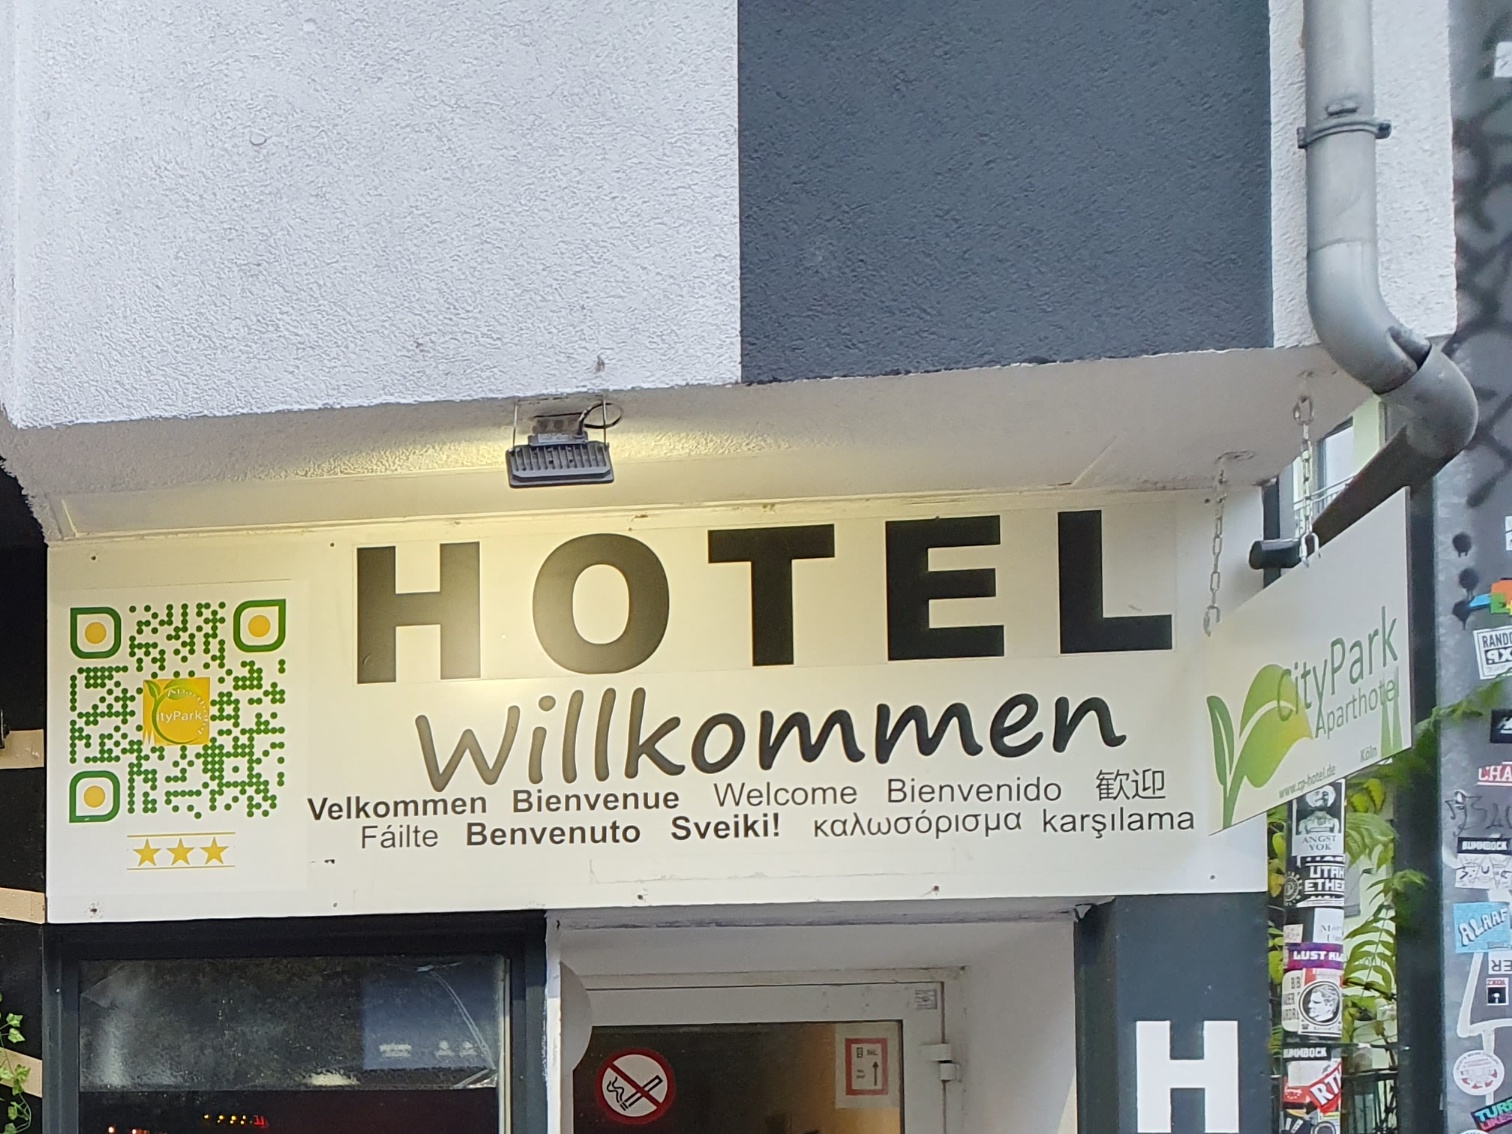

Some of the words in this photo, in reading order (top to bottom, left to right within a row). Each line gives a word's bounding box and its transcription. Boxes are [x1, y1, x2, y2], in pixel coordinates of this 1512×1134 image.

[356, 510, 1172, 684] HOTEL
[1277, 606, 1398, 722] CityPark
[415, 686, 1126, 791] Willkommen
[1360, 746, 1378, 763] Köln
[307, 791, 487, 821] Velkommen
[512, 787, 679, 815] Bienvenue
[713, 780, 857, 808] Welcome
[887, 776, 1063, 803] Bienvenido
[1095, 768, 1166, 802] 歓迎
[360, 822, 439, 849] Fáilte
[465, 821, 641, 847] Benvenuto
[671, 812, 781, 842] Sveiki!
[813, 810, 1023, 841] καλωσόρισμα
[1042, 805, 1196, 841] karşılama
